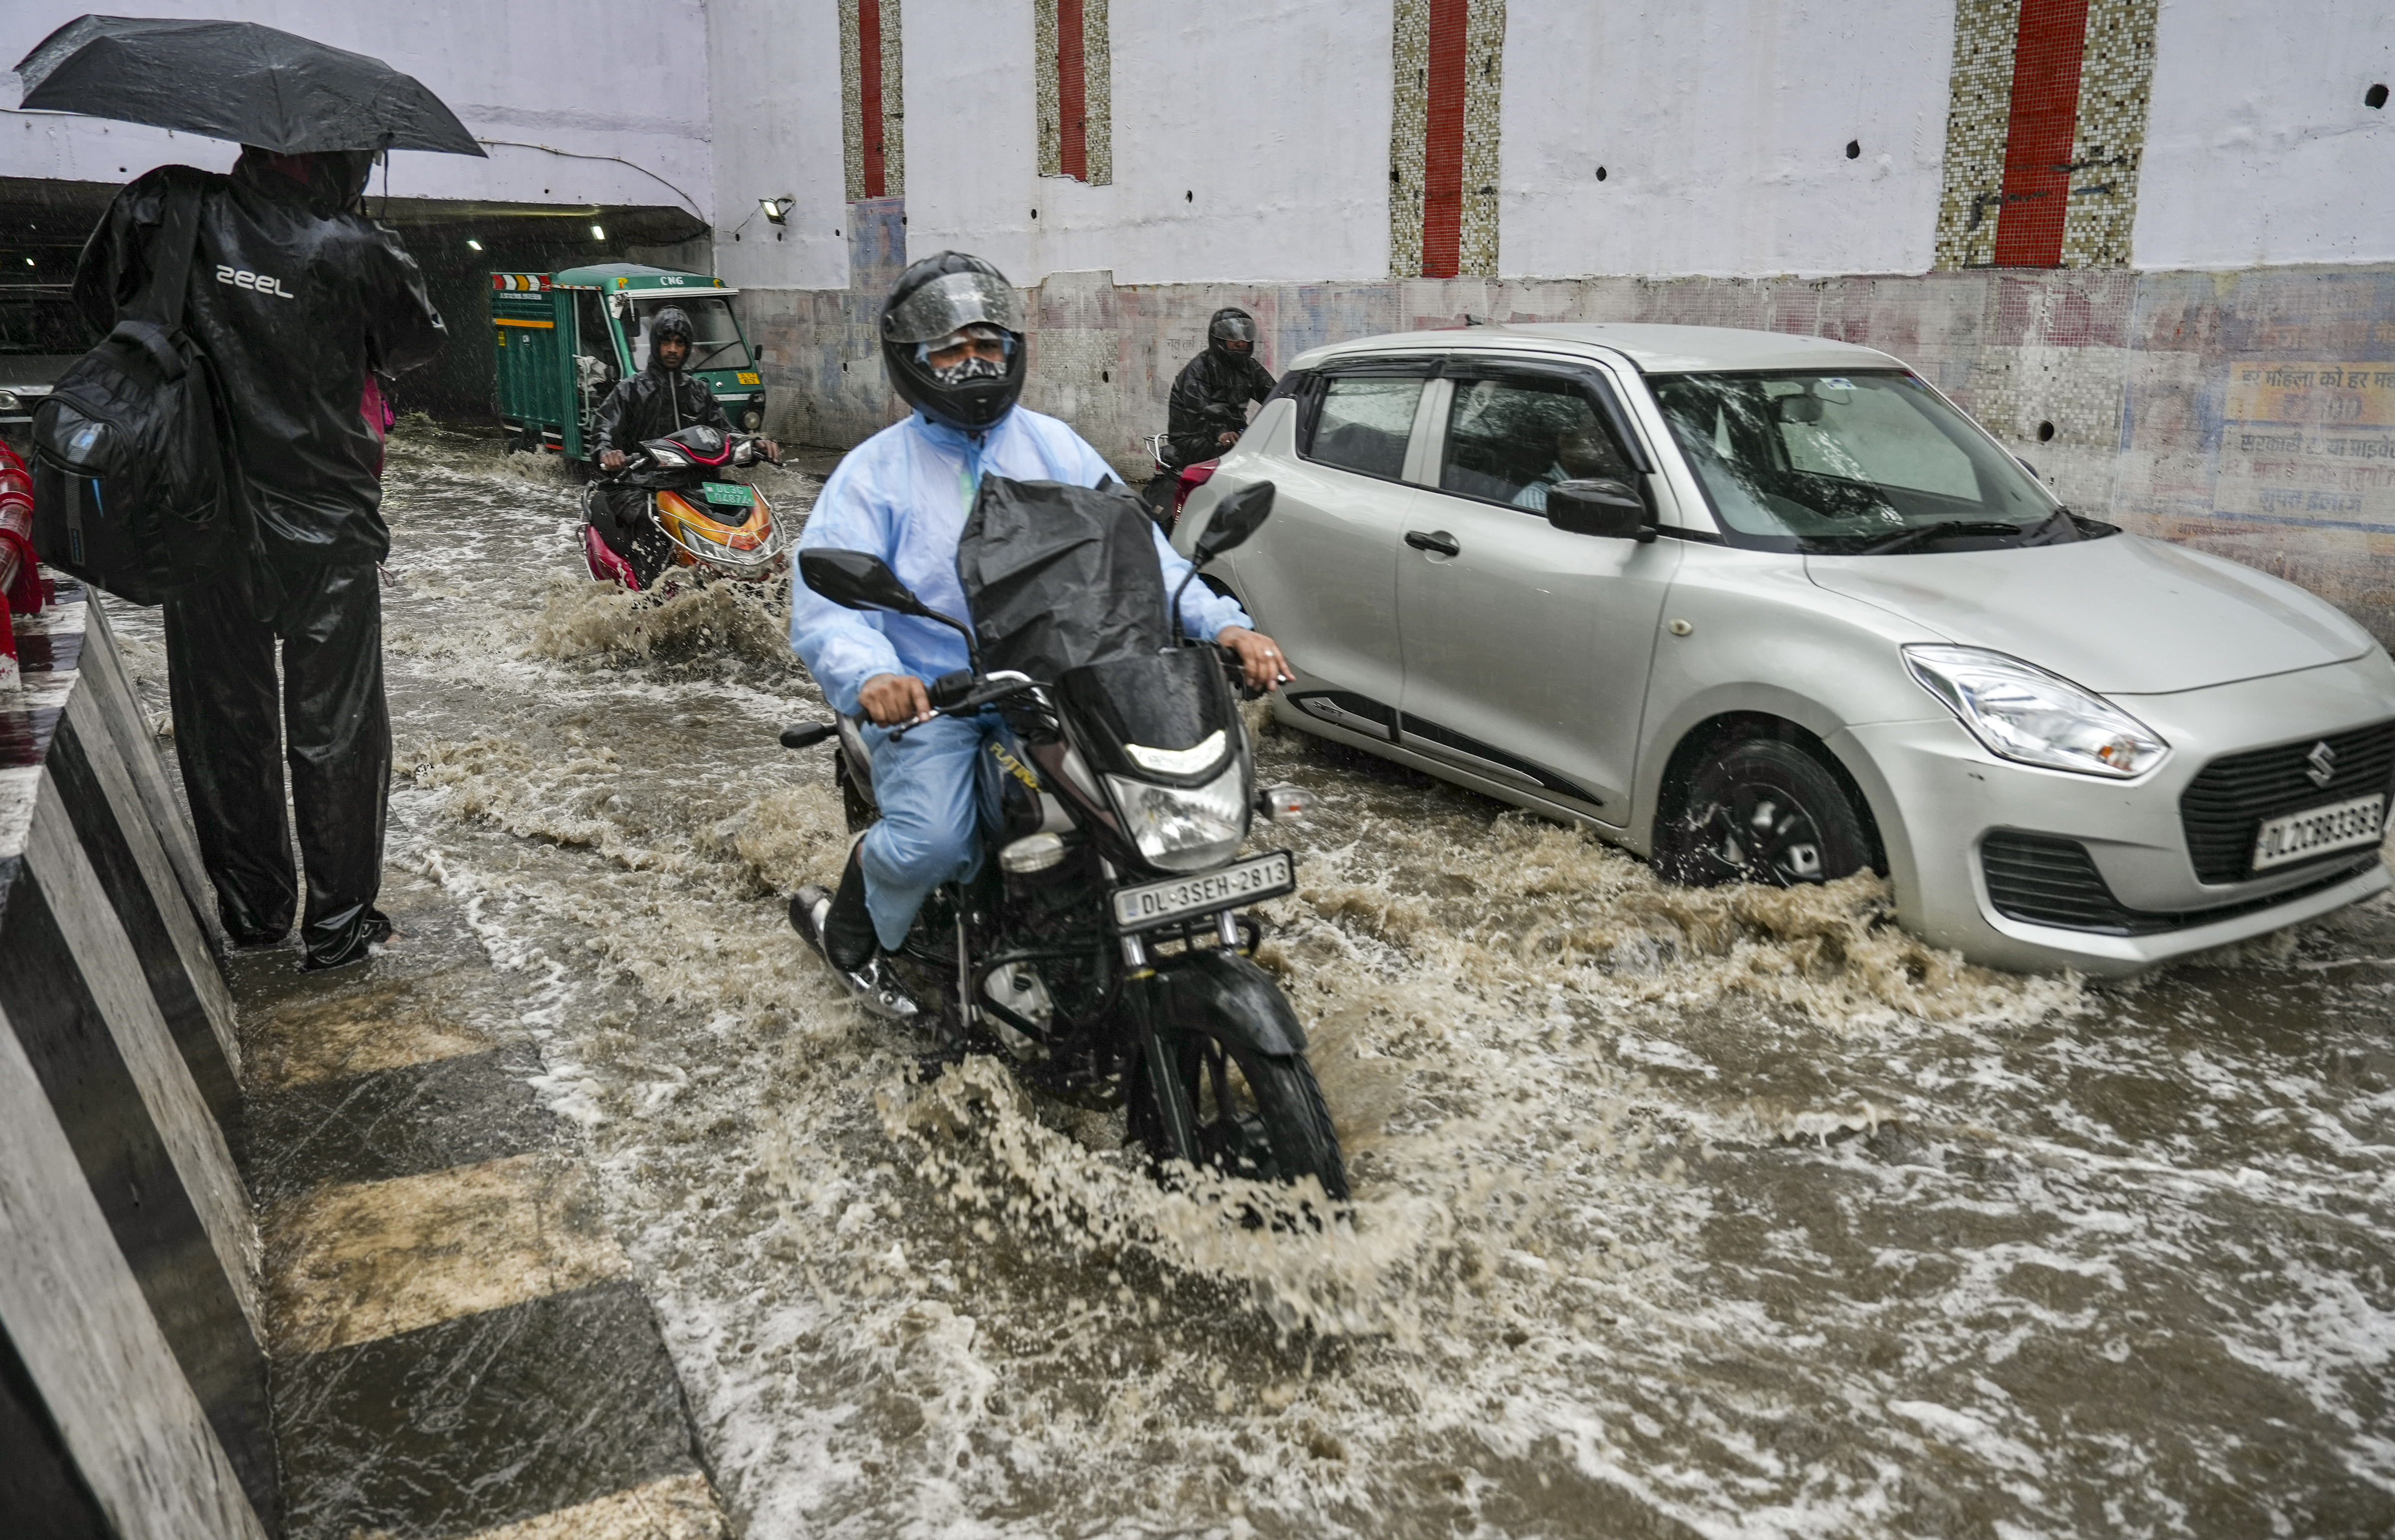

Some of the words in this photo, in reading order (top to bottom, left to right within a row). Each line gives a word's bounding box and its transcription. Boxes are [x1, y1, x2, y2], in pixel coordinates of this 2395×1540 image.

[659, 276, 685, 286] CNG
[2320, 366, 2345, 388] को
[2347, 371, 2371, 389] हर
